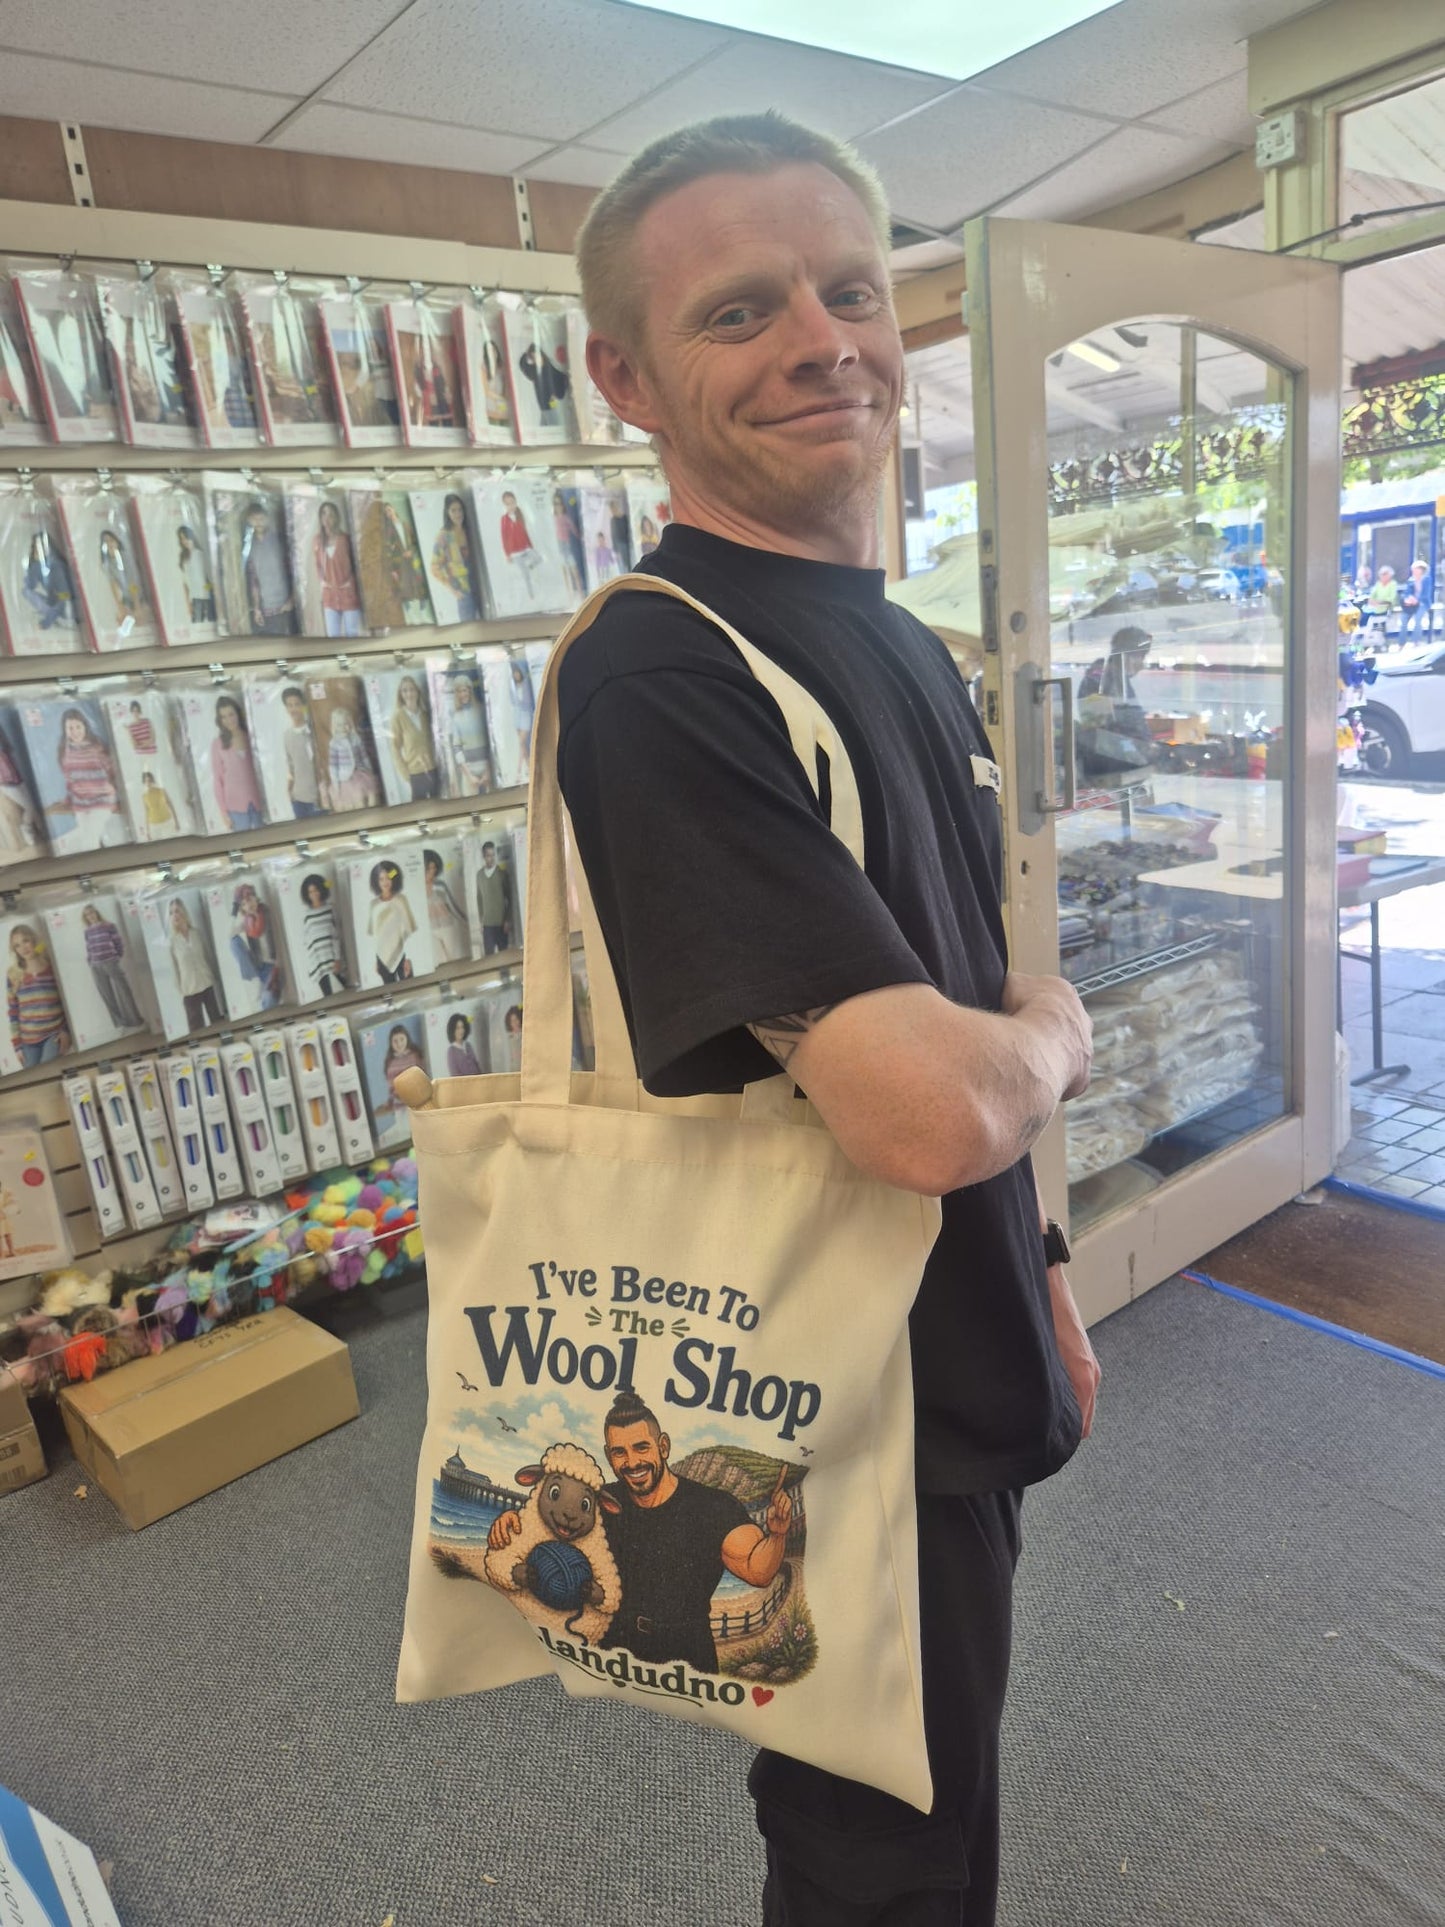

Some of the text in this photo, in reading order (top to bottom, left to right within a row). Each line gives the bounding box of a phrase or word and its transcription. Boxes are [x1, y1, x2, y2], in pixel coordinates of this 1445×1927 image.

[528, 1261, 762, 1332] I've Been To
[608, 1308, 666, 1337] The
[463, 1304, 823, 1441] Wool Shop
[537, 1626, 746, 1706] landudno
